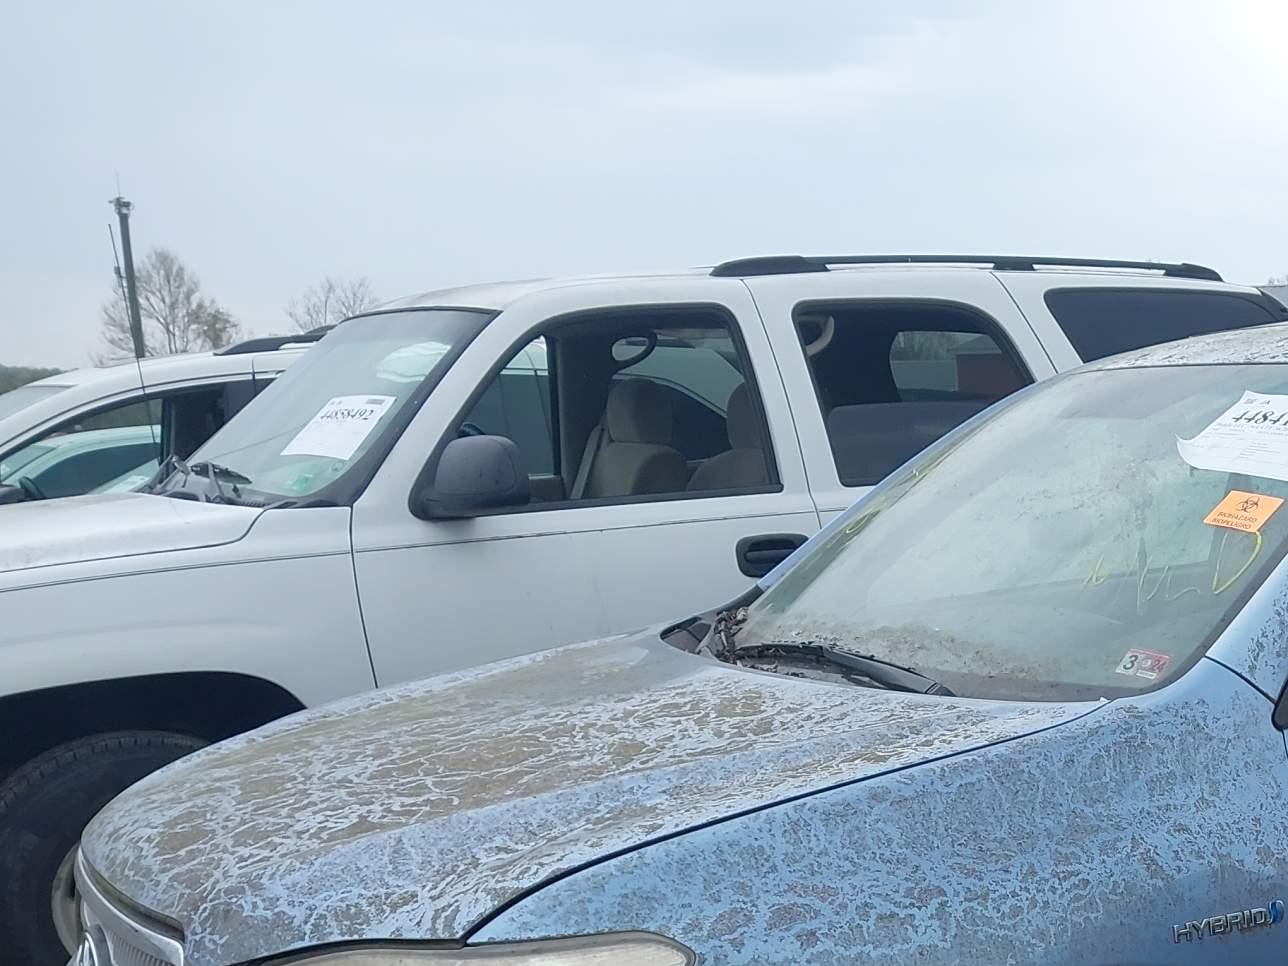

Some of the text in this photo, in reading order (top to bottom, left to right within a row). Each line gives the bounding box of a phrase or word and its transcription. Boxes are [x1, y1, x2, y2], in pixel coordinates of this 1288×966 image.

[1211, 518, 1252, 530] BIOPELIGRO
[1217, 511, 1258, 523] BIOHAZARD
[1122, 654, 1139, 671] 3
[1172, 907, 1267, 944] HYBRID
